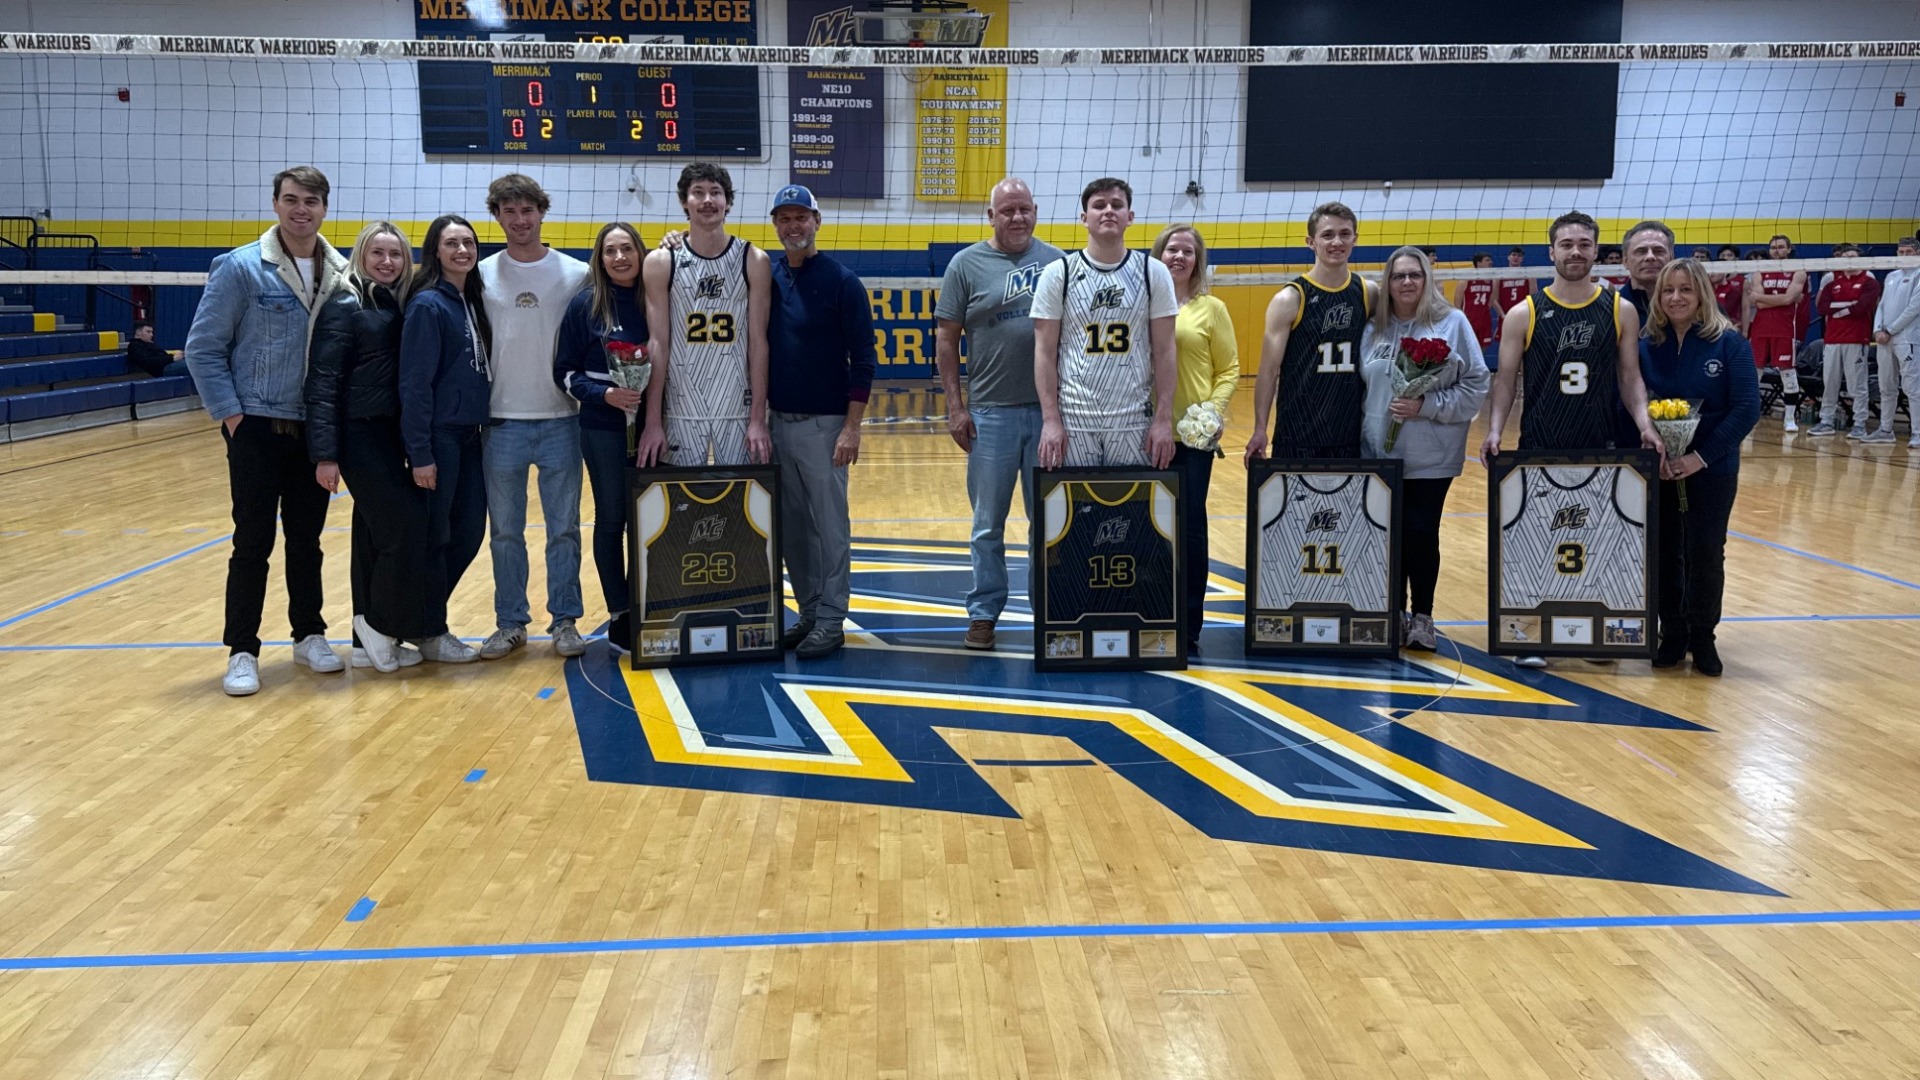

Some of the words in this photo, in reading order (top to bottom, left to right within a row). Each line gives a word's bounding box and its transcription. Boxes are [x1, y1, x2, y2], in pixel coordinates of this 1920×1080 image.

[620, 0, 751, 22] COLLEGE
[14, 35, 91, 51] WARRIORS
[159, 37, 254, 54] MERRIMACK
[260, 39, 337, 55] WARRIORS
[402, 42, 496, 59] MERRIMACK
[501, 43, 576, 60] WARRIORS
[641, 44, 732, 61] MERRIMACK
[738, 46, 810, 63] WARRIORS
[874, 48, 963, 64] MERRIMACK
[968, 49, 1039, 64] WARRIORS
[1100, 48, 1189, 64] MERRIMACK
[1195, 48, 1265, 63] WARRIORS
[1327, 47, 1414, 62] MERRIMACK
[1419, 46, 1488, 61] WARRIORS
[1549, 44, 1634, 60] MERRIMACK
[1640, 44, 1708, 60] WARRIORS
[1768, 43, 1852, 59] MERRIMACK
[1858, 42, 1920, 58] WARRIORS
[493, 65, 552, 77] MERRIMACK
[576, 73, 602, 81] PERIOD
[638, 67, 673, 78] GUEST
[807, 71, 866, 80] BASKETBALL
[934, 73, 990, 81] BASKETBALL
[528, 81, 543, 106] 0
[591, 85, 597, 104] 1
[821, 84, 852, 94] NE10
[945, 86, 978, 96] NCAA
[661, 83, 676, 108] 0
[800, 97, 873, 108] CHAMPIONS
[921, 100, 1002, 110] TOURNAMENT
[503, 109, 526, 118] FOULS
[567, 110, 595, 118] PLAYER
[598, 110, 617, 118] FOUL
[656, 111, 679, 119] FOULS
[792, 113, 833, 123] 1991-92
[512, 118, 524, 137] 0
[541, 119, 553, 138] 2
[631, 120, 643, 139] 2
[665, 120, 677, 139] 0
[792, 134, 834, 143] 1999-00
[504, 142, 528, 150] SCORE
[580, 143, 606, 151] MATCH
[657, 143, 681, 152] SCORE
[793, 159, 834, 169] 2018-19
[1473, 293, 1487, 305] 24
[1510, 288, 1517, 301] 5
[686, 312, 735, 344] 23
[1085, 322, 1130, 355] 13
[1316, 341, 1356, 373] 11
[1559, 361, 1589, 395] 3
[1301, 543, 1344, 576] 11
[1556, 541, 1586, 577] 3
[681, 552, 736, 586] 23
[1088, 554, 1136, 589] 13
